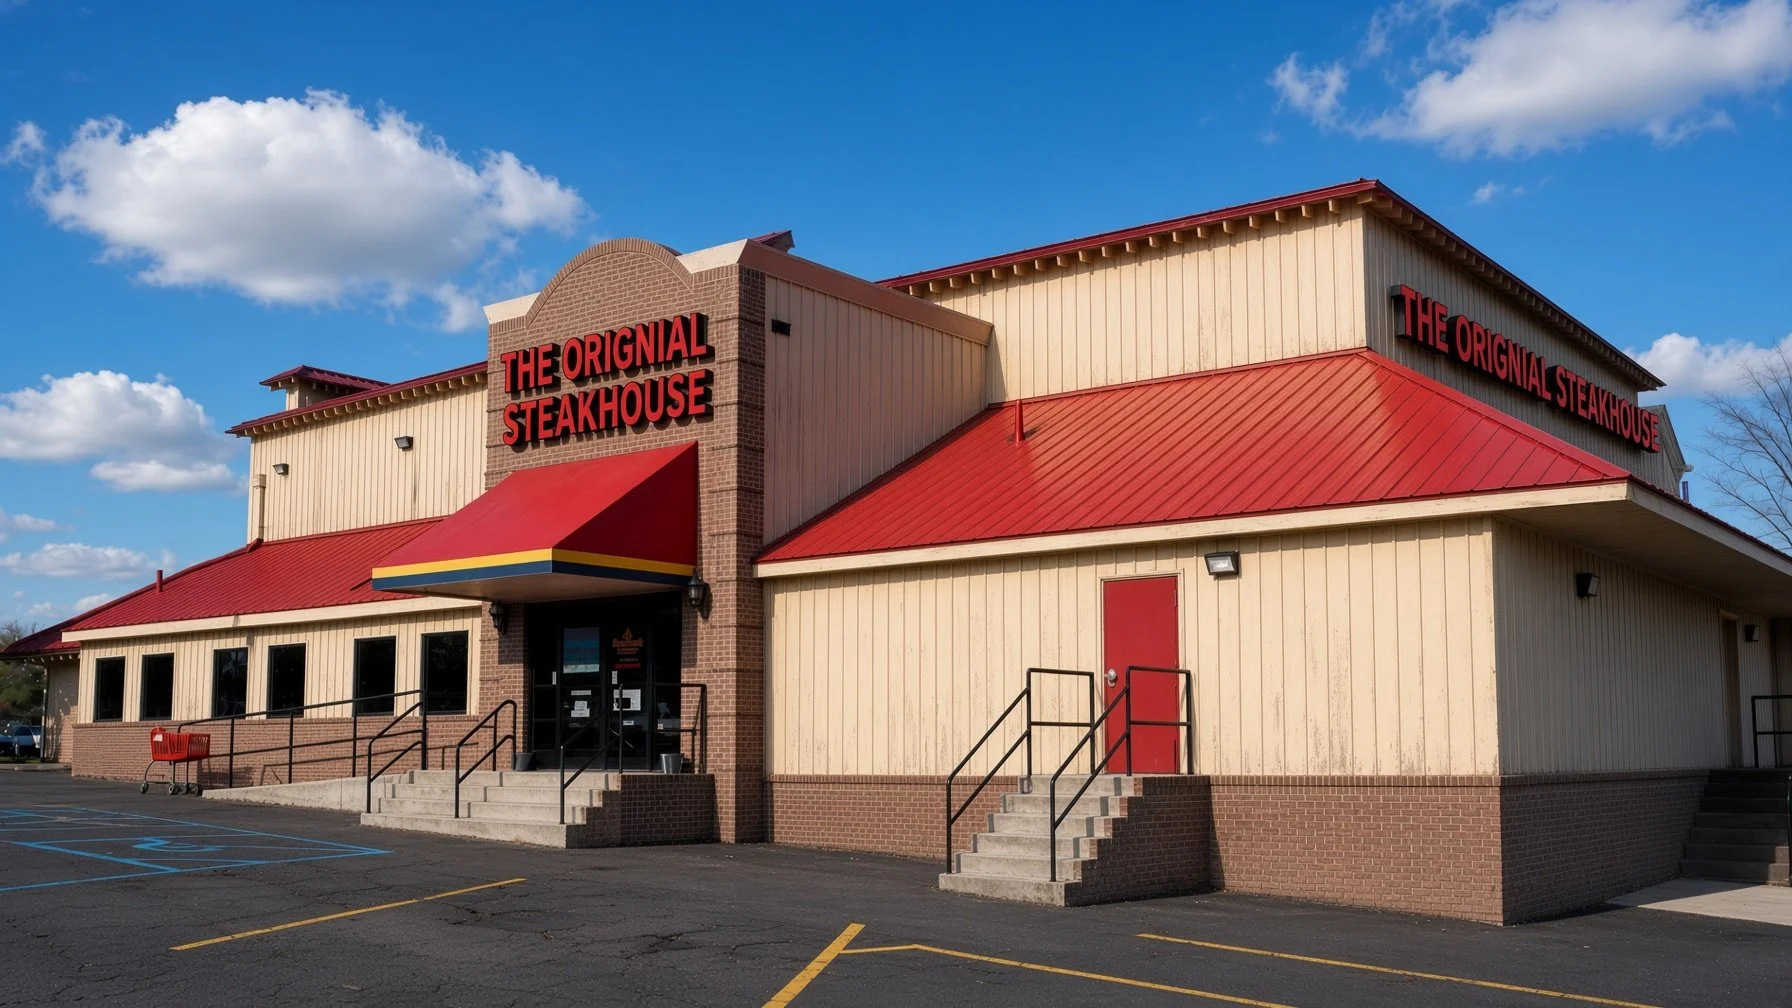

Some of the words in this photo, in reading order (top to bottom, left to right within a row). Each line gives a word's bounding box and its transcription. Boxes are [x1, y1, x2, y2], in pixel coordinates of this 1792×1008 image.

[501, 343, 554, 393] THE
[562, 313, 708, 380] ORIGNIAL
[1400, 284, 1448, 353] THE
[1455, 314, 1551, 401] ORIGNIAL
[1555, 365, 1660, 452] STEAKHOUSE
[502, 369, 707, 446] STEAKHOUSE
